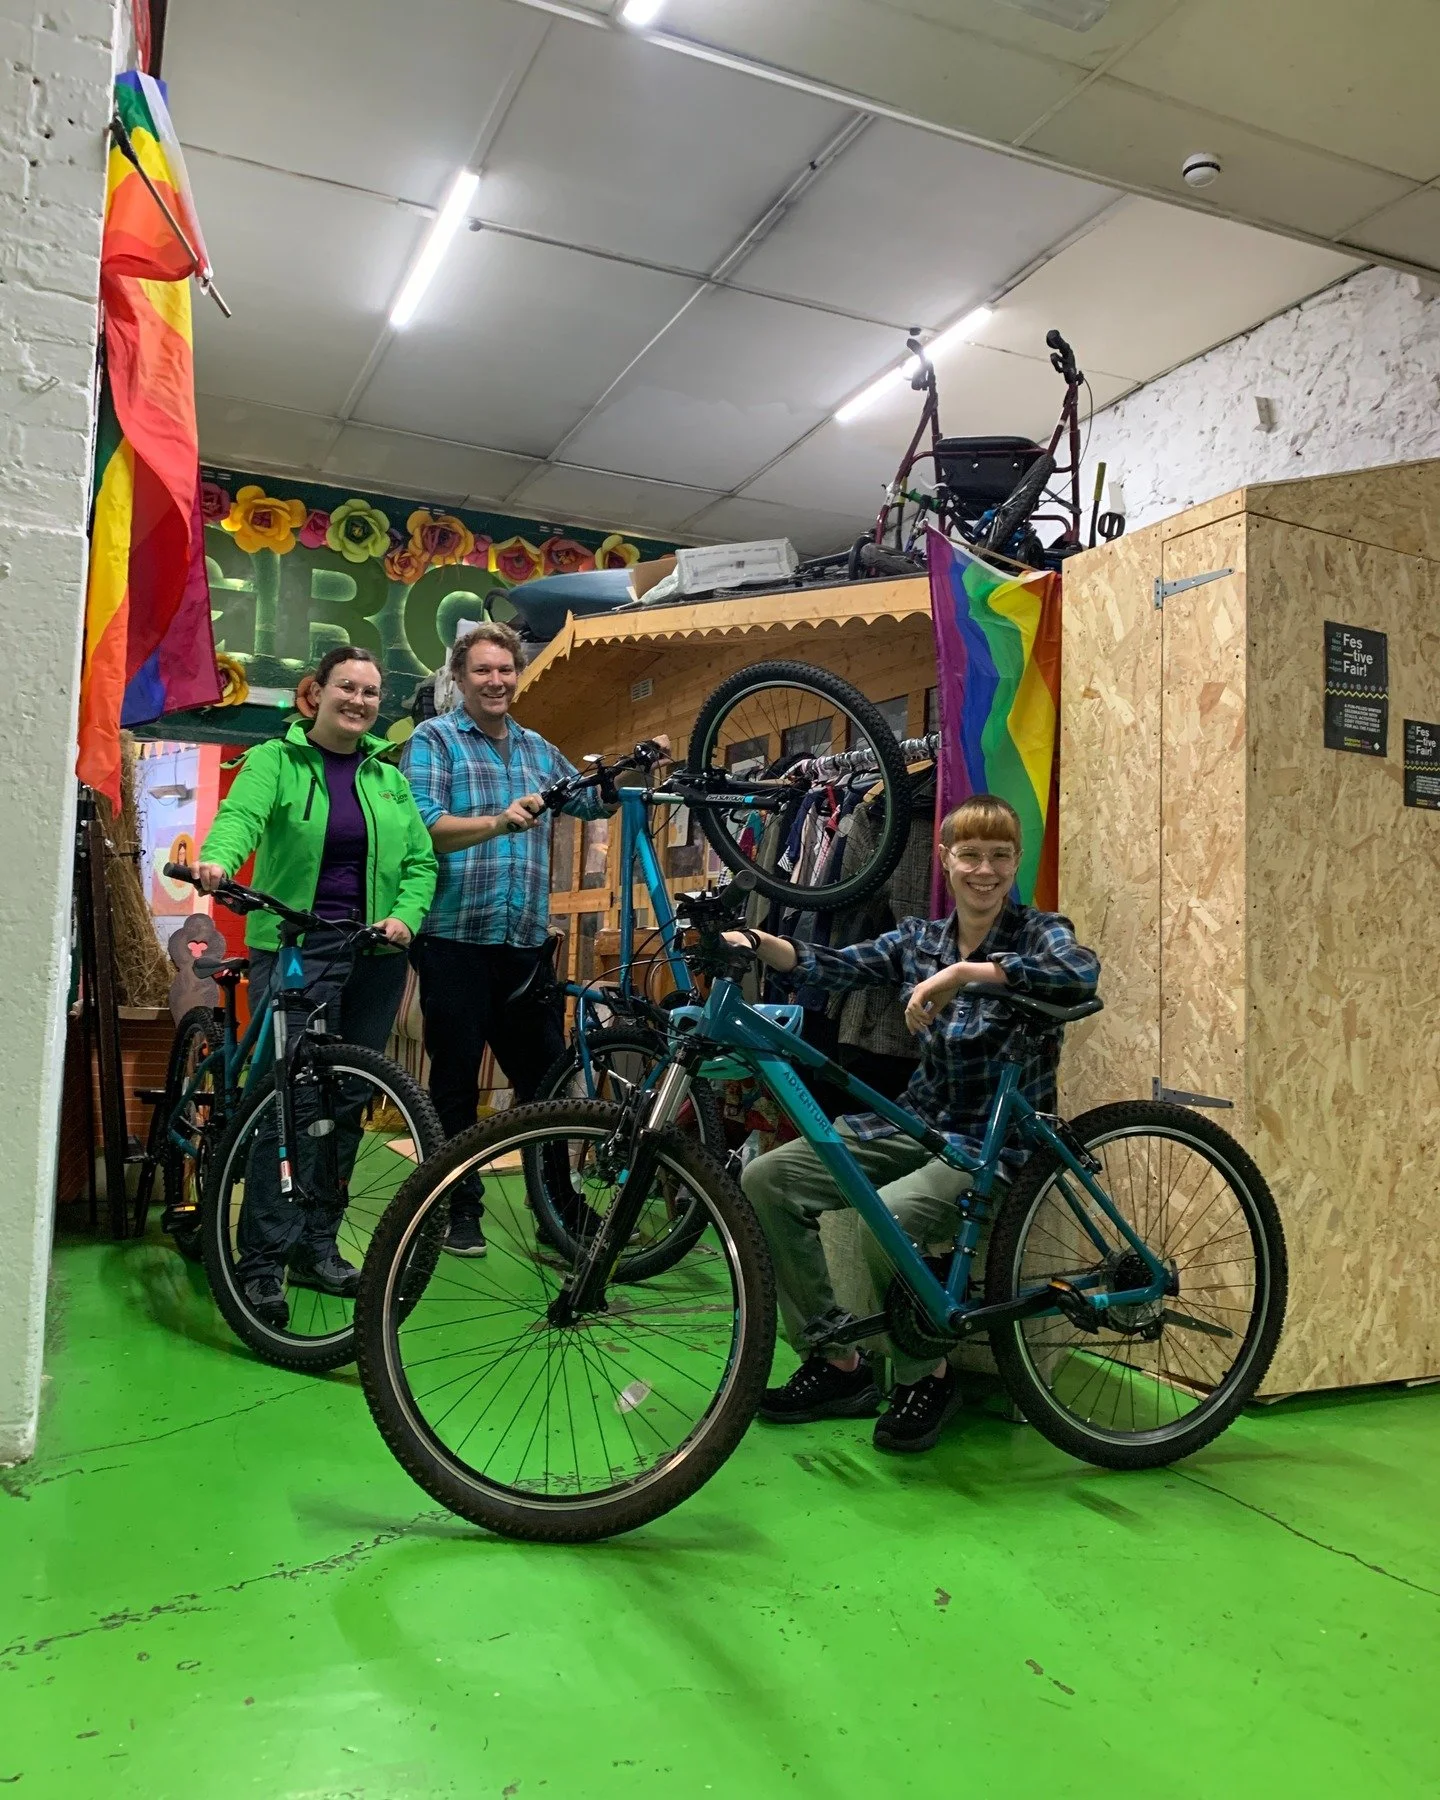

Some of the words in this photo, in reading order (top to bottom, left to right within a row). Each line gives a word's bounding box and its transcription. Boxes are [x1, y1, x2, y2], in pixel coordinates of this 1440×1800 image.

[1343, 632, 1363, 649] Fes
[1343, 660, 1367, 677] Fair!
[1416, 726, 1430, 737] Fes
[1416, 745, 1432, 756] Fair!
[783, 1071, 832, 1137] ADVENTURE
